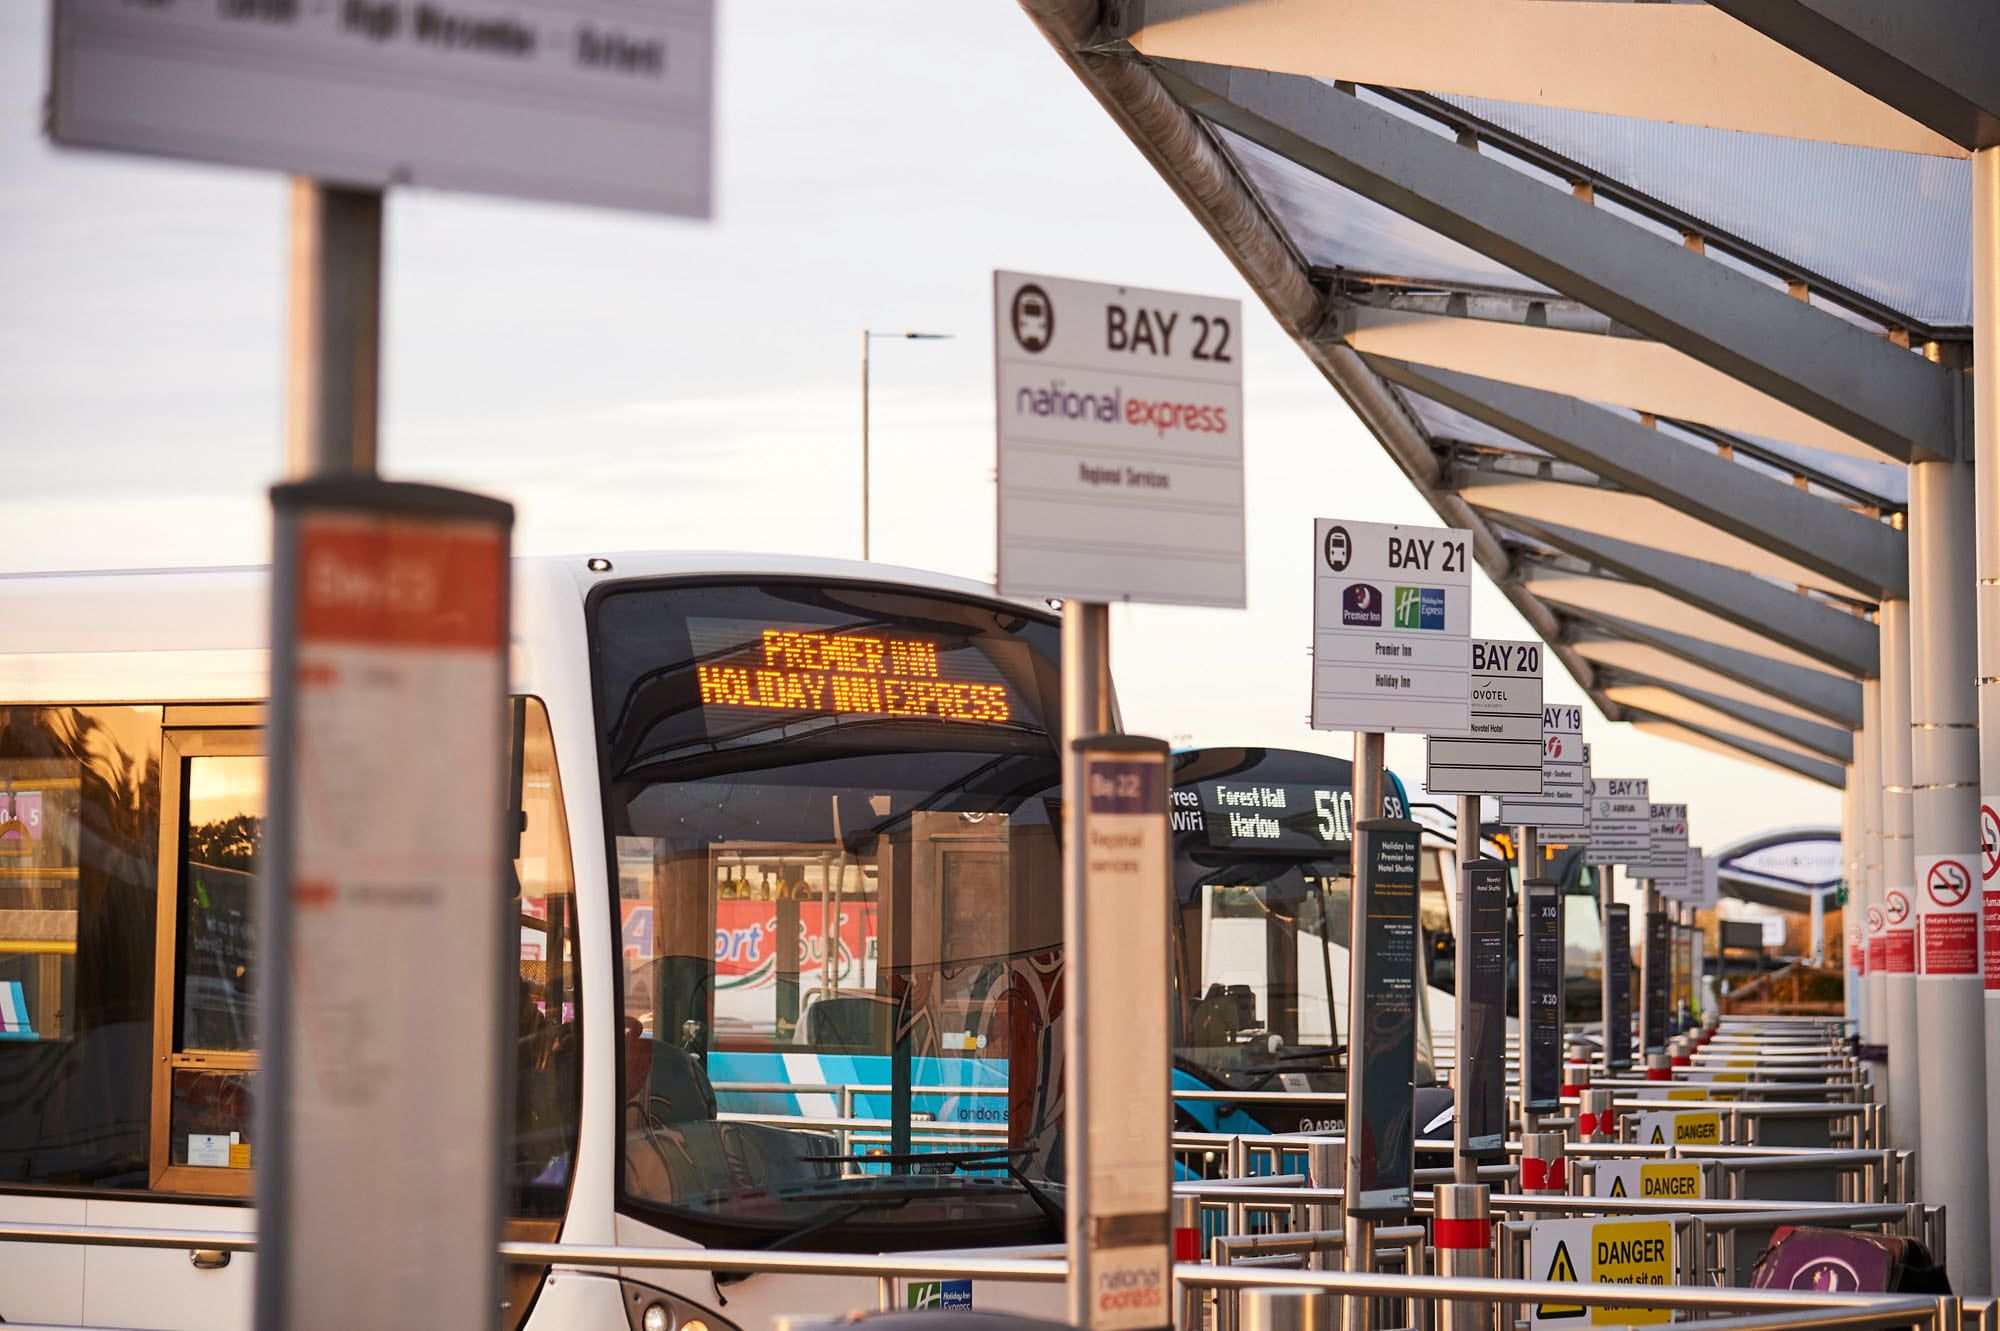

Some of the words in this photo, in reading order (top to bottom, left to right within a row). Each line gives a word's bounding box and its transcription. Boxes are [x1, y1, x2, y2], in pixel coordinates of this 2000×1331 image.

[1106, 305, 1178, 356] BAY
[1191, 315, 1232, 363] 22
[1017, 380, 1122, 425] national
[1124, 397, 1228, 437] express
[1388, 537, 1435, 570] BAY
[1442, 541, 1465, 572] 21
[1344, 609, 1370, 620] Premier
[1370, 611, 1381, 621] Inn
[1421, 604, 1444, 616] Express
[763, 631, 886, 674] PREMIER
[890, 640, 938, 677] INN
[1375, 642, 1400, 656] Premier
[1402, 644, 1412, 656] Inn
[1472, 644, 1513, 671] BAY
[1517, 646, 1538, 672] 20
[1375, 674, 1399, 689] Holiday
[1401, 675, 1411, 688] Inn
[699, 666, 824, 710] HOLIDAY
[831, 675, 881, 714] INN
[884, 679, 1009, 721] EXPRESS
[1471, 690, 1508, 701] OVOTEL
[1543, 708, 1561, 728] AY
[1566, 709, 1581, 730] 19
[1471, 724, 1490, 732] Novotel
[1490, 725, 1504, 733] Hotel
[1609, 781, 1632, 795] BAY
[1635, 781, 1648, 795] 17
[1216, 786, 1260, 807] Forest
[1261, 788, 1287, 808] Hall
[1314, 790, 1353, 841] 510
[1650, 806, 1672, 818] BAY
[1169, 811, 1204, 832] WiFi
[1229, 812, 1281, 838] Harlow
[1382, 841, 1405, 853] Holiday
[1405, 842, 1415, 851] Inn
[1381, 853, 1405, 862] Premier
[1405, 854, 1415, 862] Inn
[1378, 864, 1394, 872] Hotel
[1394, 864, 1415, 873] Shuttle
[1541, 906, 1557, 918] X10
[1541, 993, 1557, 1005] X30
[957, 1107, 1000, 1120] london
[1677, 1123, 1715, 1140] DANGER
[1645, 1177, 1696, 1195] DANGER
[1597, 1239, 1665, 1265] DANGER
[1600, 1274, 1614, 1285] Do
[1617, 1273, 1634, 1285] not
[1636, 1272, 1648, 1286] sit
[1650, 1274, 1664, 1286] on
[943, 1291, 962, 1302] Holiday
